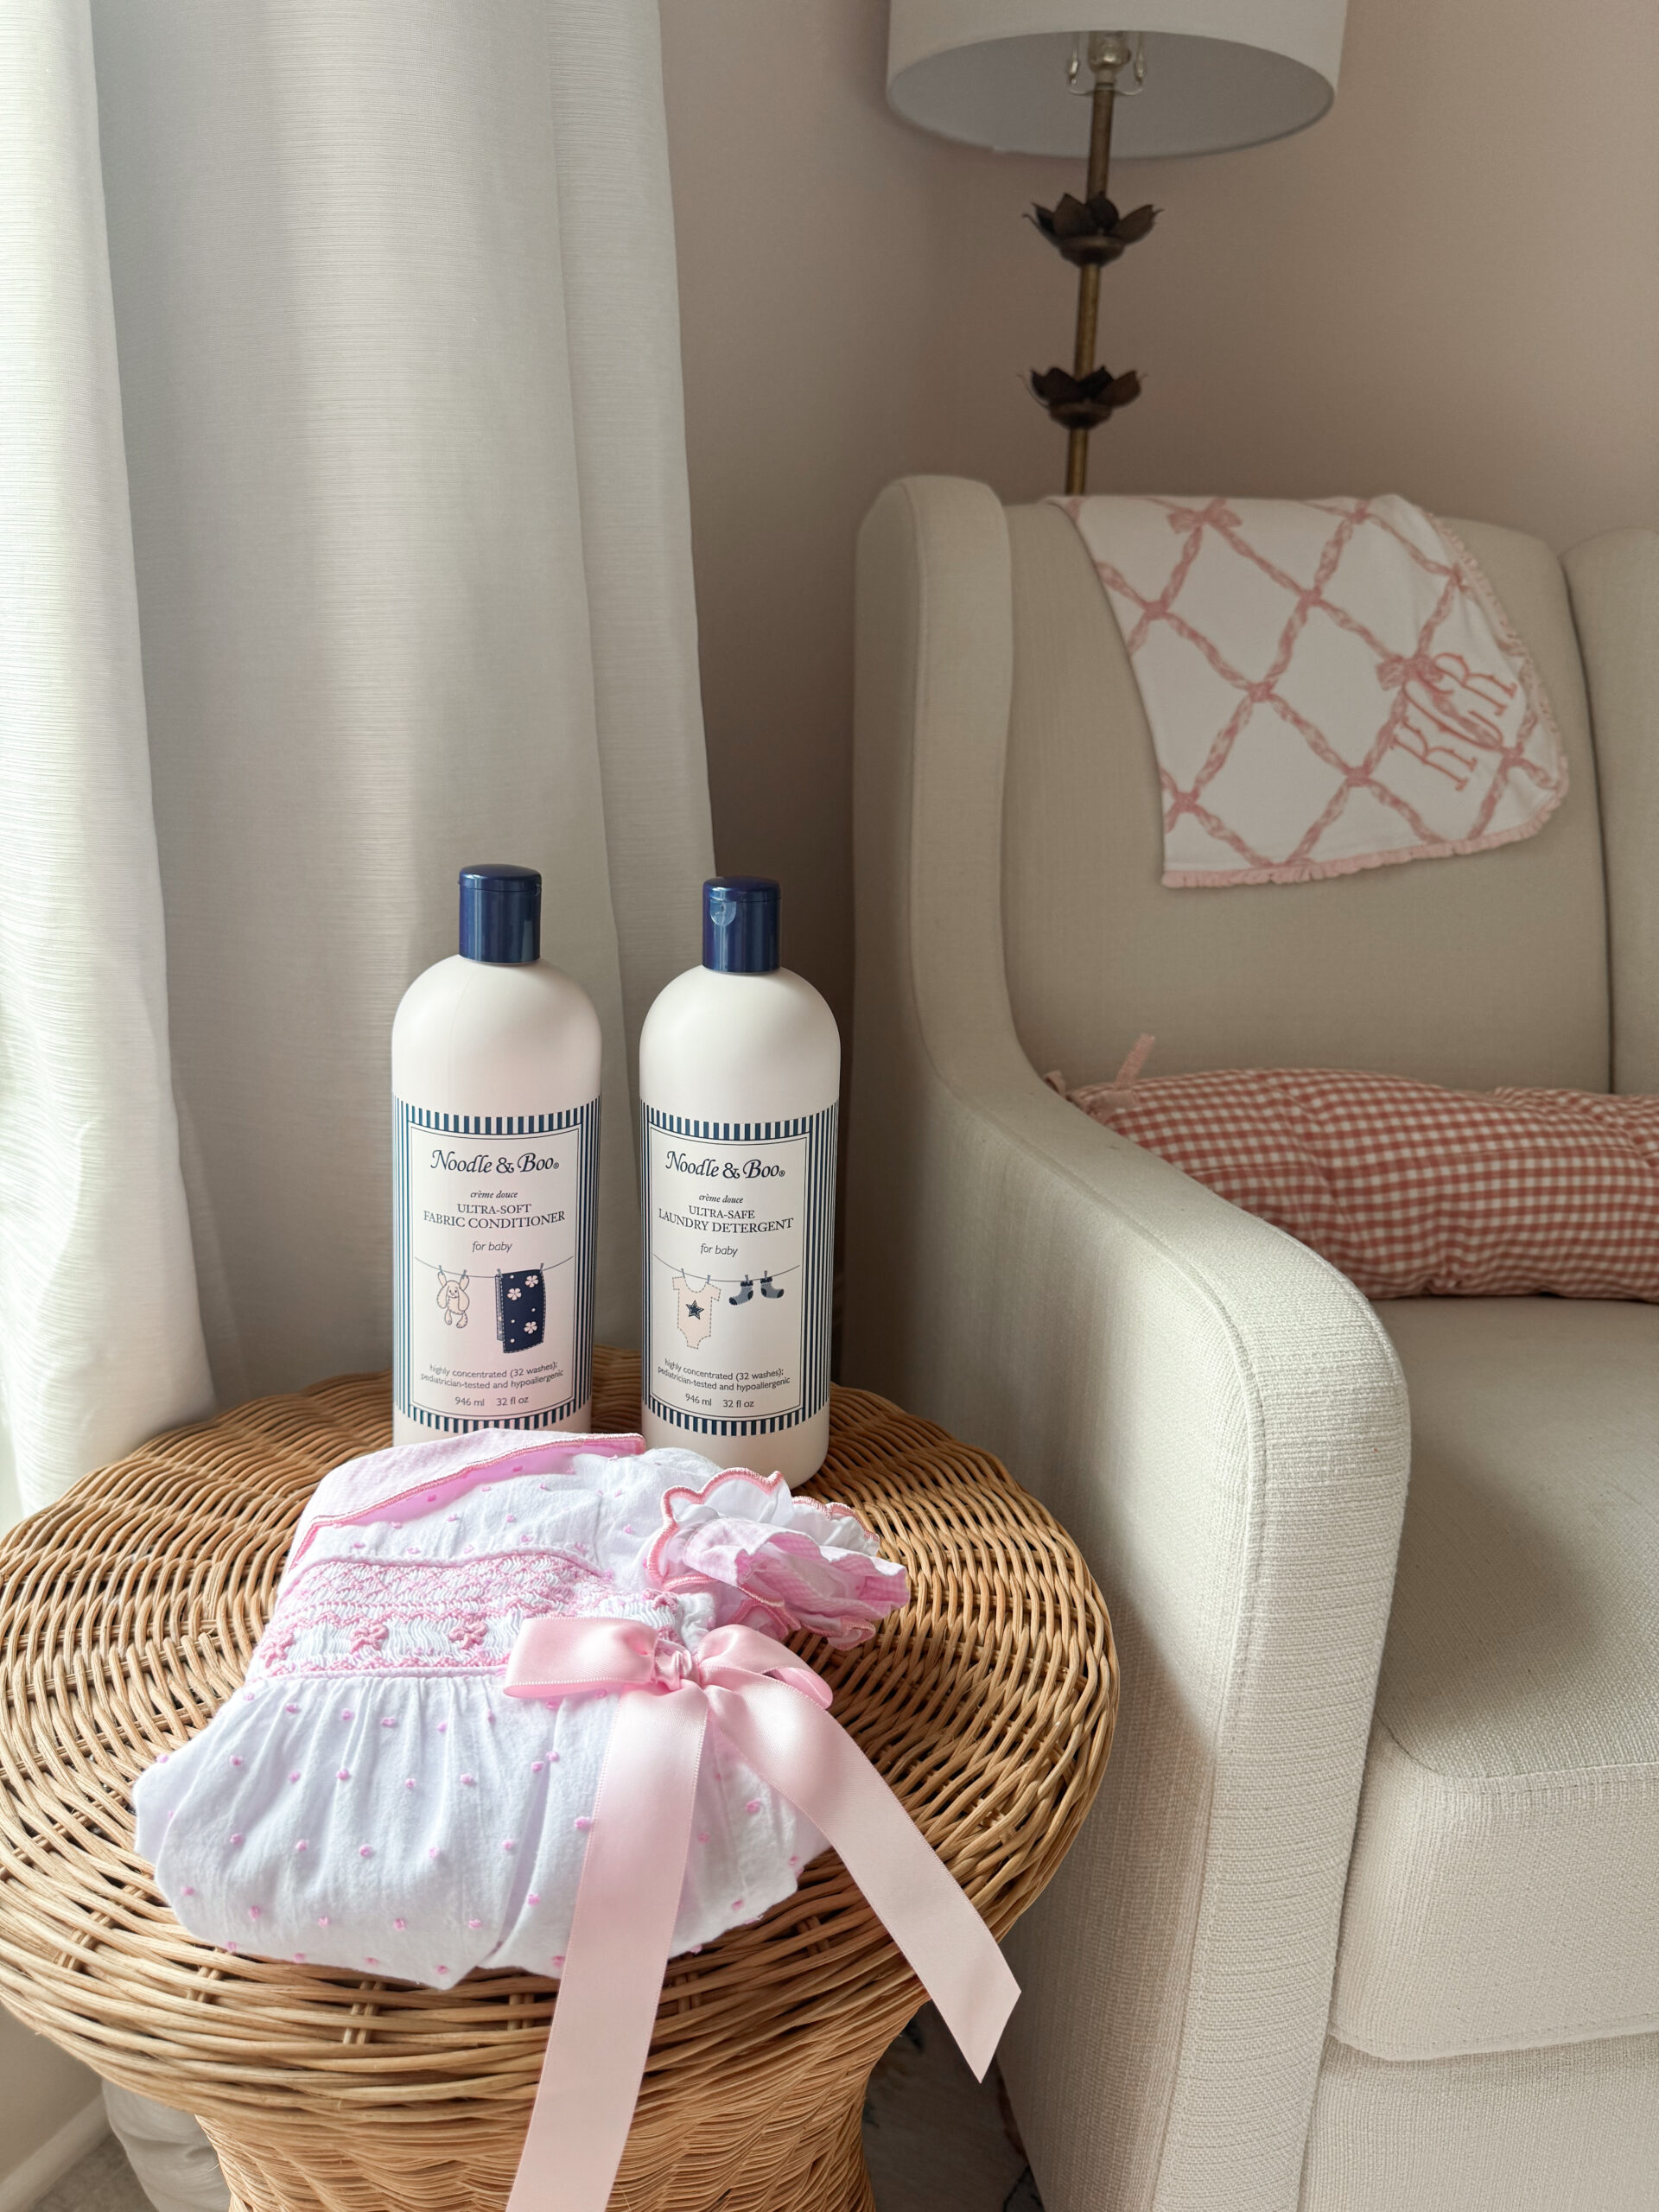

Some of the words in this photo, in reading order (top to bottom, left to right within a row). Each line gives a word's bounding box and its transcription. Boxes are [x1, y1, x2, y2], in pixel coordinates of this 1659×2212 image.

[430, 1150, 492, 1173] Noodle
[496, 1158, 514, 1173] &
[665, 1151, 719, 1177] Noodle
[722, 1163, 741, 1178] &
[699, 1193, 721, 1202] crème
[722, 1195, 743, 1204] douce
[457, 1204, 531, 1214] ULTRA-SOFT
[688, 1205, 755, 1218] ULTRA-SAFE
[424, 1211, 465, 1228] FABRIC
[468, 1211, 565, 1228] CONDITIONER
[659, 1209, 709, 1230] LAUNDRY
[712, 1217, 793, 1233] DETERGENT
[473, 1241, 486, 1252] for
[489, 1242, 512, 1252] baby
[701, 1243, 713, 1254] for
[715, 1244, 738, 1257] baby
[430, 1363, 450, 1376] highly
[453, 1370, 506, 1378] concentrated
[665, 1358, 681, 1373] highly
[683, 1367, 733, 1380] concentrated
[511, 1370, 563, 1388] hypoallergenic
[737, 1376, 790, 1392] hypoallergenic
[455, 1397, 471, 1406] 946
[685, 1394, 700, 1404] 946
[702, 1397, 711, 1406] ml
